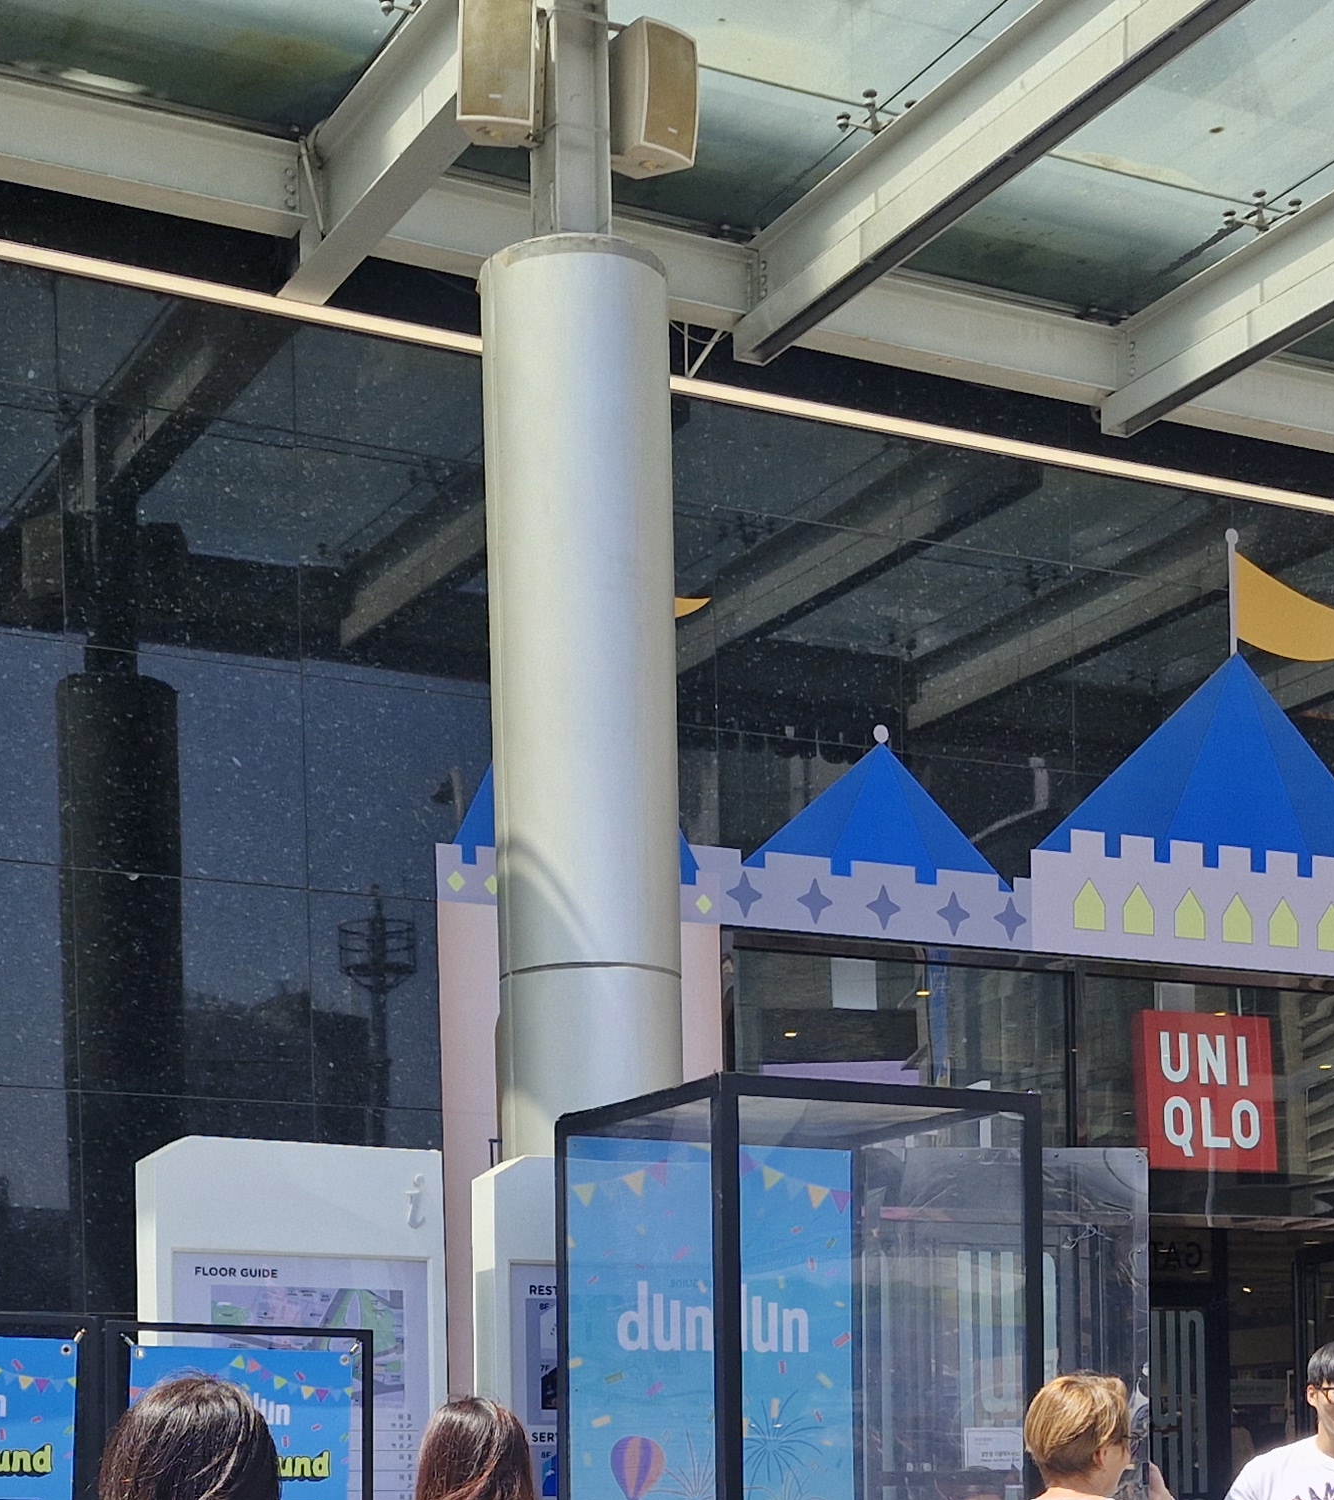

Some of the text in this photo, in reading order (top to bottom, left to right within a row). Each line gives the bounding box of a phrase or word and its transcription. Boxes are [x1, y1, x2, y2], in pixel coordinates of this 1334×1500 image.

[1160, 1031, 1248, 1086] UNI
[1164, 1095, 1260, 1156] QLO
[194, 1266, 278, 1278] FLOOR GUIDE
[278, 1451, 332, 1481] und
